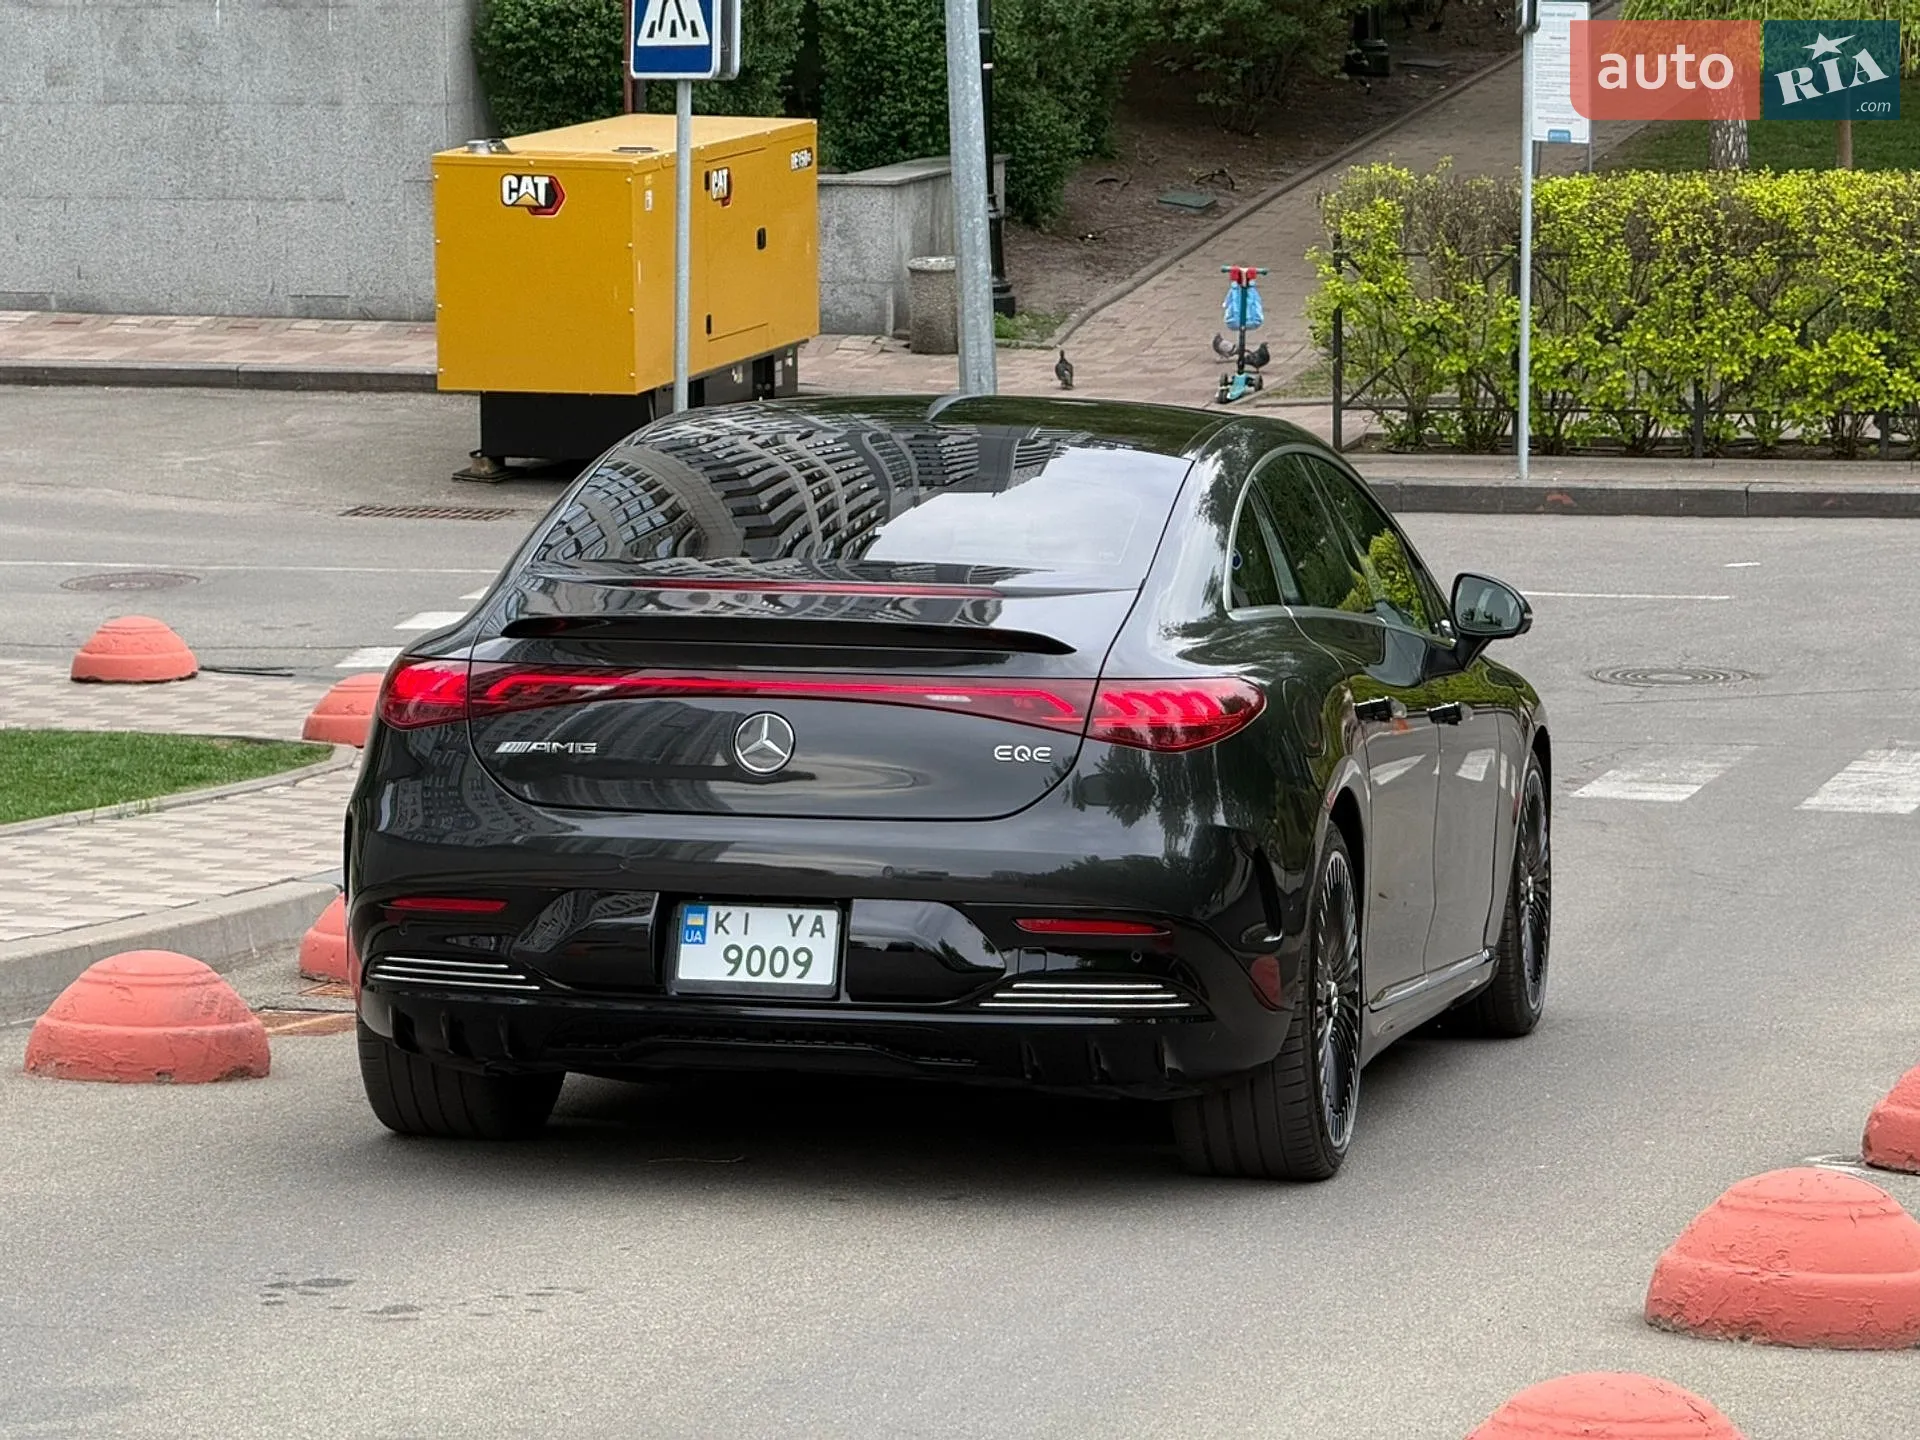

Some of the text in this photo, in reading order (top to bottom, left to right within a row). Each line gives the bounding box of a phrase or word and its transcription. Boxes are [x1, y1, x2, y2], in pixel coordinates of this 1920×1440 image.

[502, 174, 549, 207] CAT
[711, 167, 729, 200] CAT
[994, 745, 1052, 763] EQE
[685, 930, 703, 943] UA
[787, 913, 826, 938] YA
[722, 943, 814, 980] 9009
